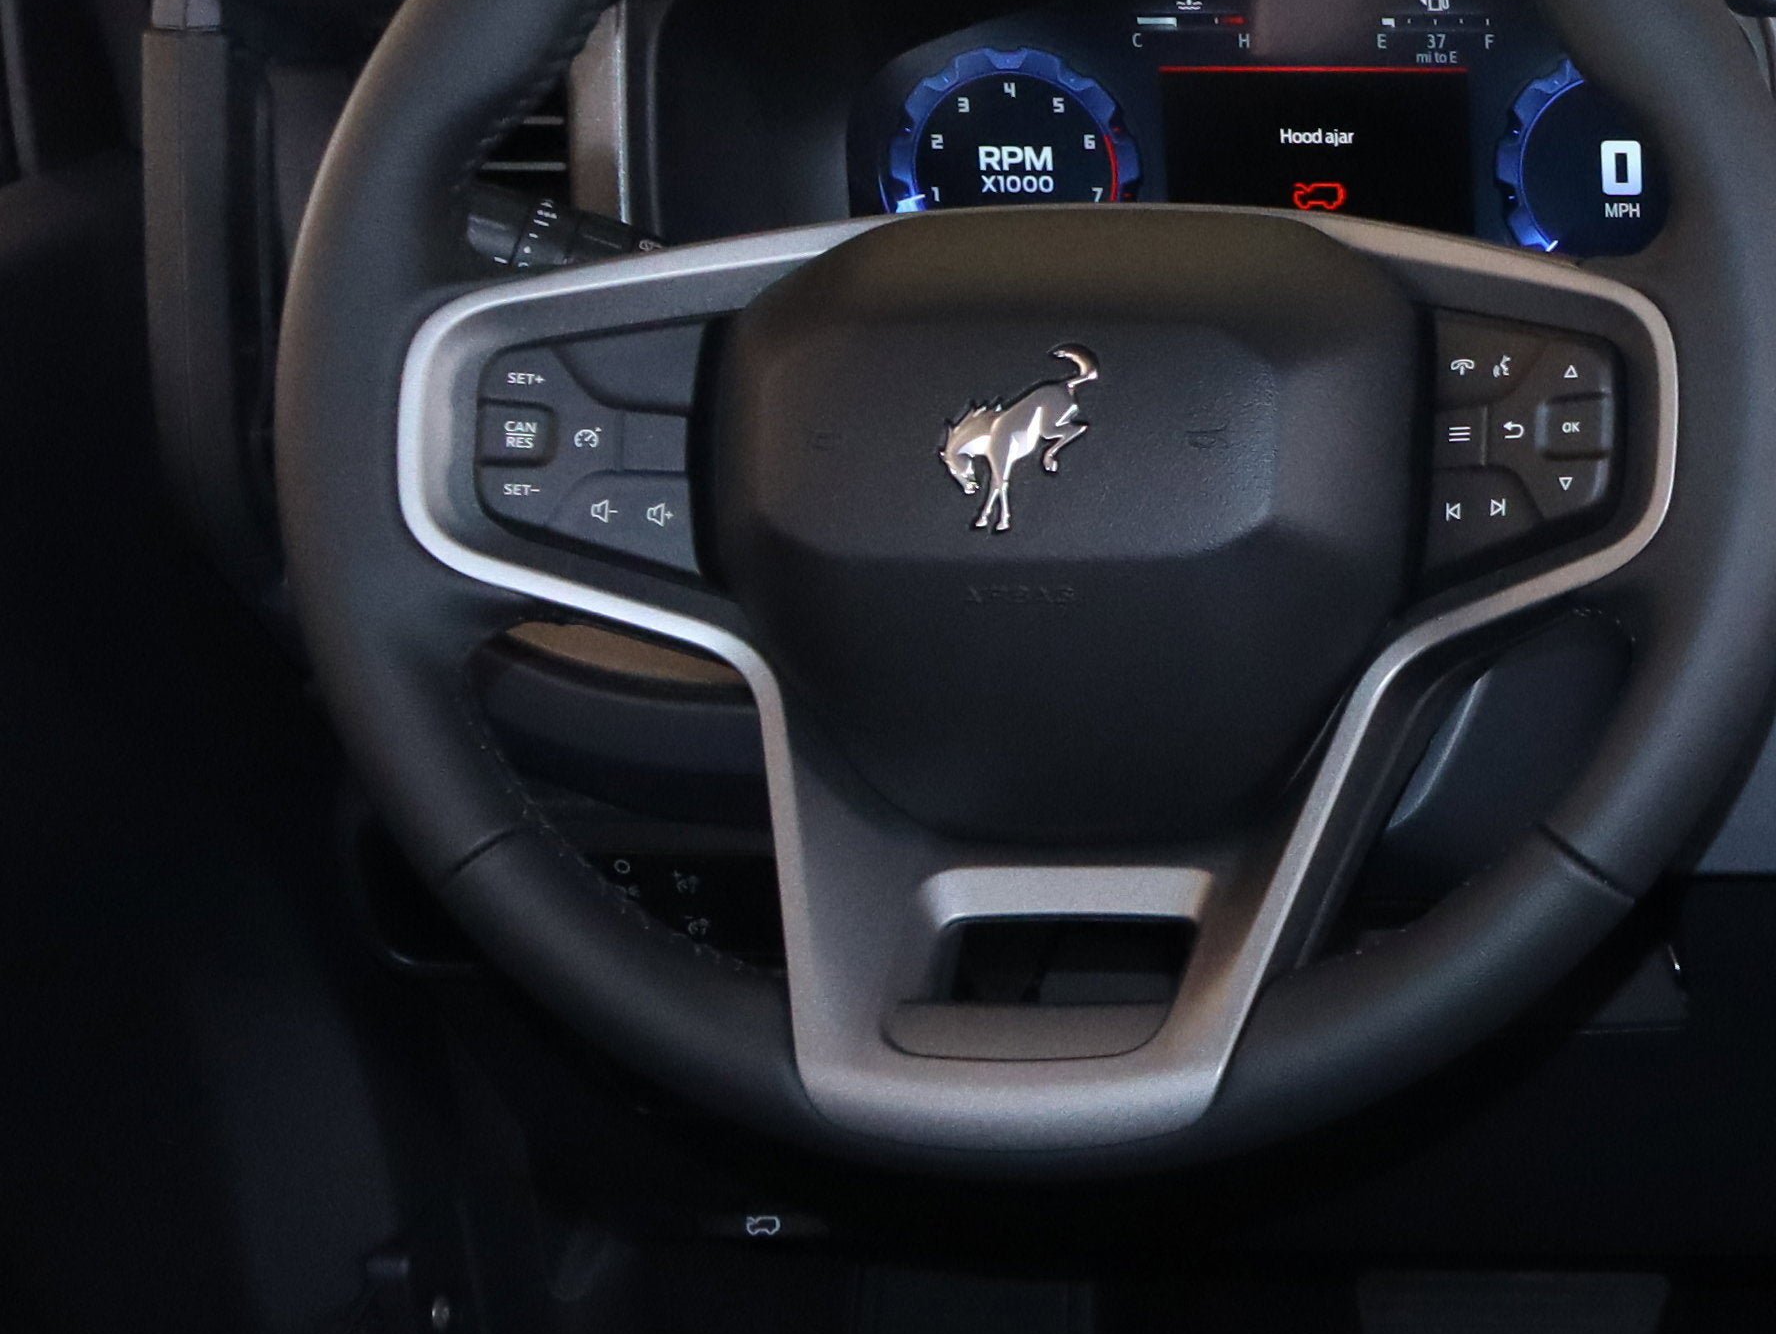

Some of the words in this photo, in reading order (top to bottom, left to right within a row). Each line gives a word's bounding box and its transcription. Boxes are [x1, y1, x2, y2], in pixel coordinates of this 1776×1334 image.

[1132, 34, 1142, 48] C
[1239, 34, 1250, 48] H
[1377, 34, 1386, 48] E
[1426, 33, 1446, 49] 37
[1485, 35, 1494, 49] F
[1415, 51, 1429, 63] mi
[1432, 52, 1442, 63] to
[1447, 51, 1457, 63] E
[1004, 82, 1016, 97] 4
[958, 97, 970, 113] 3
[1053, 97, 1065, 113] 5
[931, 134, 944, 149] 2
[1084, 134, 1096, 150] 6
[1280, 128, 1321, 144] Hood
[1325, 128, 1354, 149] ajar
[978, 146, 1054, 171] RPM
[1600, 140, 1642, 196] 0
[981, 175, 1054, 193] X1000
[931, 187, 940, 202] 1
[1092, 188, 1104, 203] 7
[1604, 202, 1641, 218] MPH
[507, 372, 546, 385] SET+
[504, 421, 537, 433] CAN
[1562, 421, 1580, 434] OK
[506, 436, 534, 449] RES
